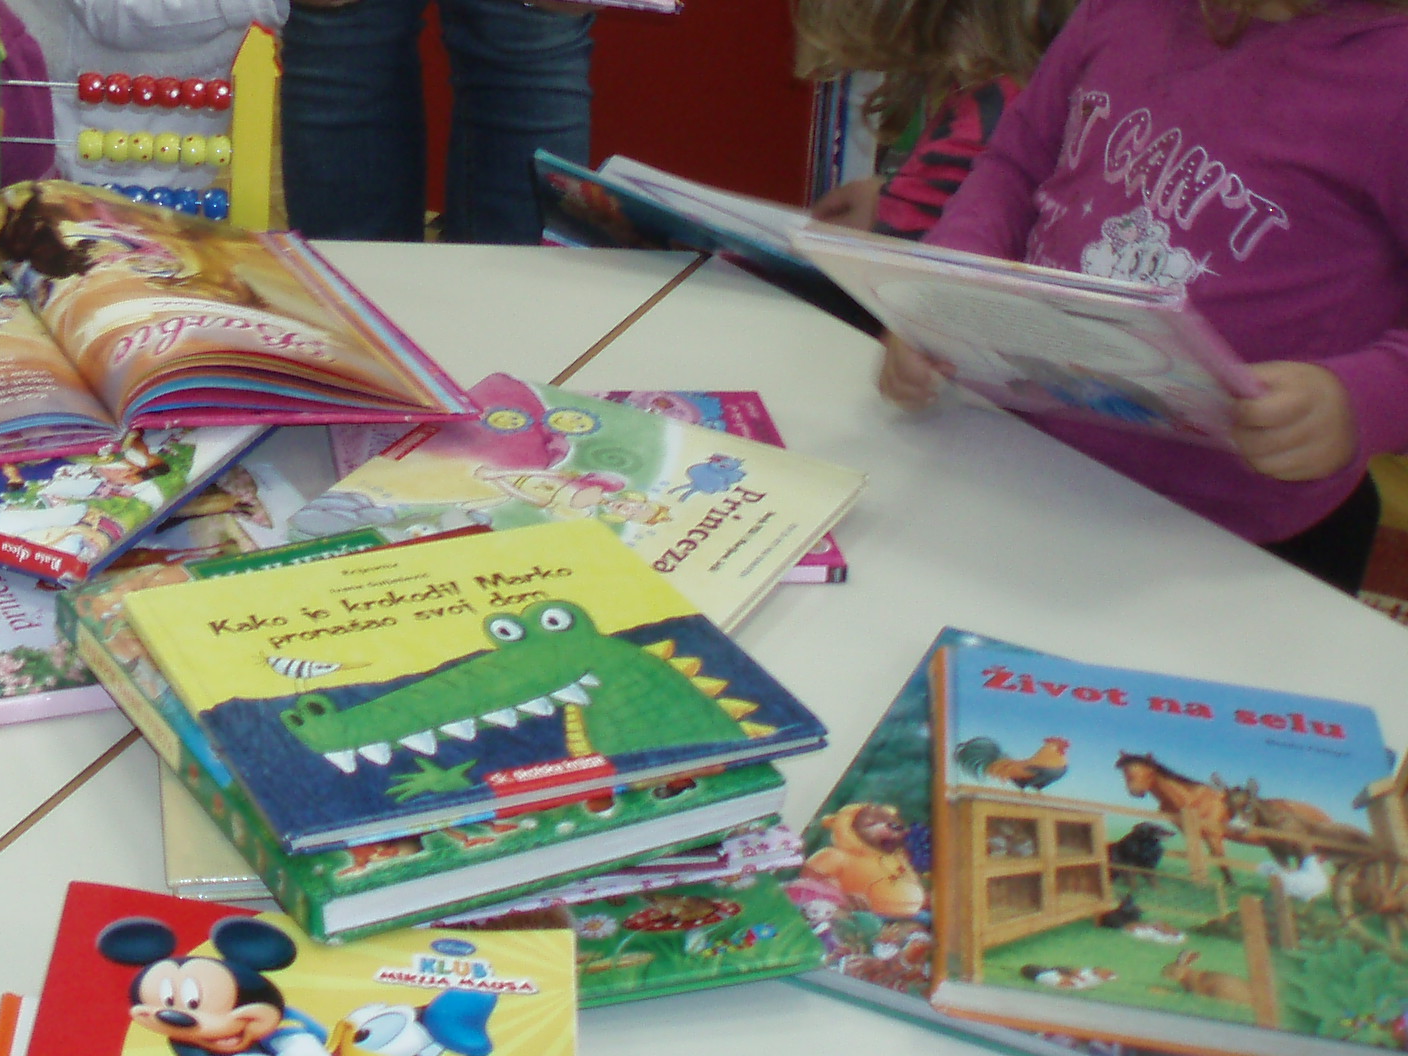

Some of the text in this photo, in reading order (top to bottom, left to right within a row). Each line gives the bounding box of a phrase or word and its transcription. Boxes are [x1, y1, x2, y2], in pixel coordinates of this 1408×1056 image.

[1103, 108, 1290, 262] CAN'T
[653, 486, 768, 574] Princeza
[208, 613, 289, 637] Kako
[340, 579, 461, 613] krokodil
[473, 563, 575, 591] Marko
[269, 587, 549, 650] pronašao svoj dom
[980, 664, 1347, 740] Život na selu
[420, 957, 488, 979] KLUB
